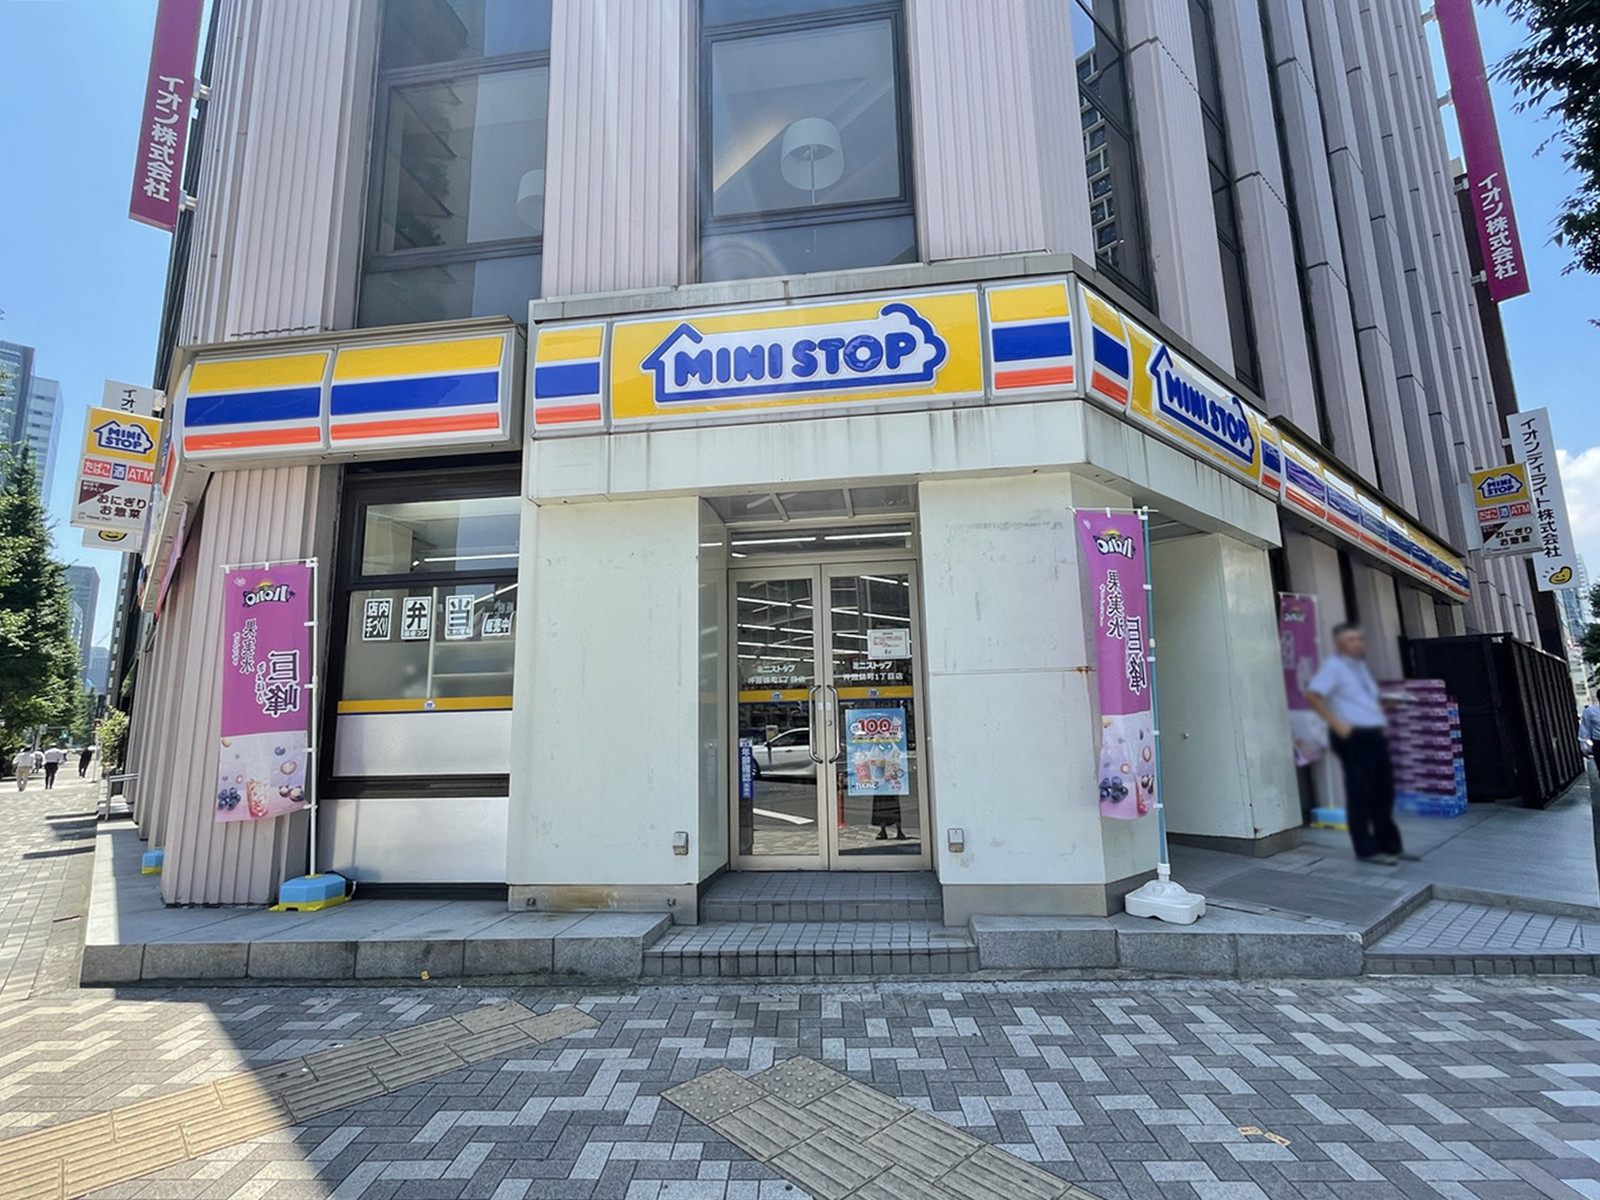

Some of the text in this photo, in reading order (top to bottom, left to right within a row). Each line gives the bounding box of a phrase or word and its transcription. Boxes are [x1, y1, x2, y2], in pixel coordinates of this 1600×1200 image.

[143, 75, 185, 203] イオン株式会社
[1478, 172, 1518, 280] イオン株式会社
[675, 332, 917, 387] MINI STOP
[1165, 370, 1250, 447] MINI STOP
[108, 427, 142, 441] MINI
[106, 436, 142, 449] STOP
[84, 460, 110, 476] たばこ
[128, 468, 153, 482] ATM
[1487, 478, 1513, 489] MINI
[1487, 484, 1514, 495] STOP
[1521, 417, 1562, 559] イオンディライト株式会社
[97, 494, 147, 509] おにぎり
[1511, 503, 1530, 515] ATM
[100, 505, 141, 519] お惣菜
[1495, 527, 1533, 539] おにぎり
[367, 602, 389, 616] 店内
[407, 601, 427, 629] 弁
[450, 599, 471, 627] 当
[852, 661, 893, 671] ミニストップ
[858, 718, 892, 733] 100
